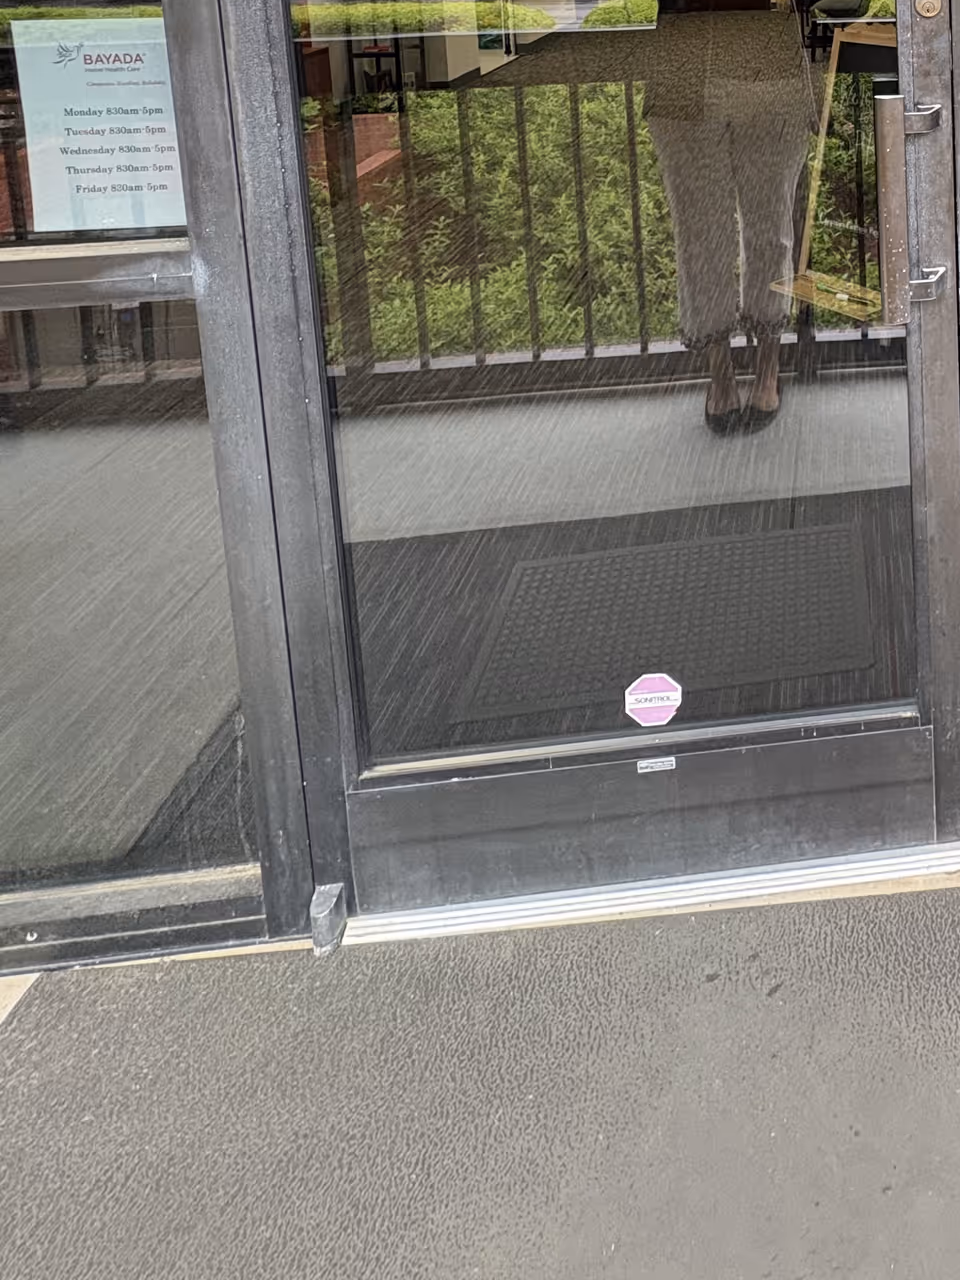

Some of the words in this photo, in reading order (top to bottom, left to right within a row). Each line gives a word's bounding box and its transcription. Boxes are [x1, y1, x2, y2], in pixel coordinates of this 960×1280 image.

[64, 108, 104, 117] Monday
[64, 127, 107, 137] Tuesday
[59, 146, 116, 156] Wednesday
[65, 165, 114, 175] Thursday
[75, 185, 108, 194] Friday
